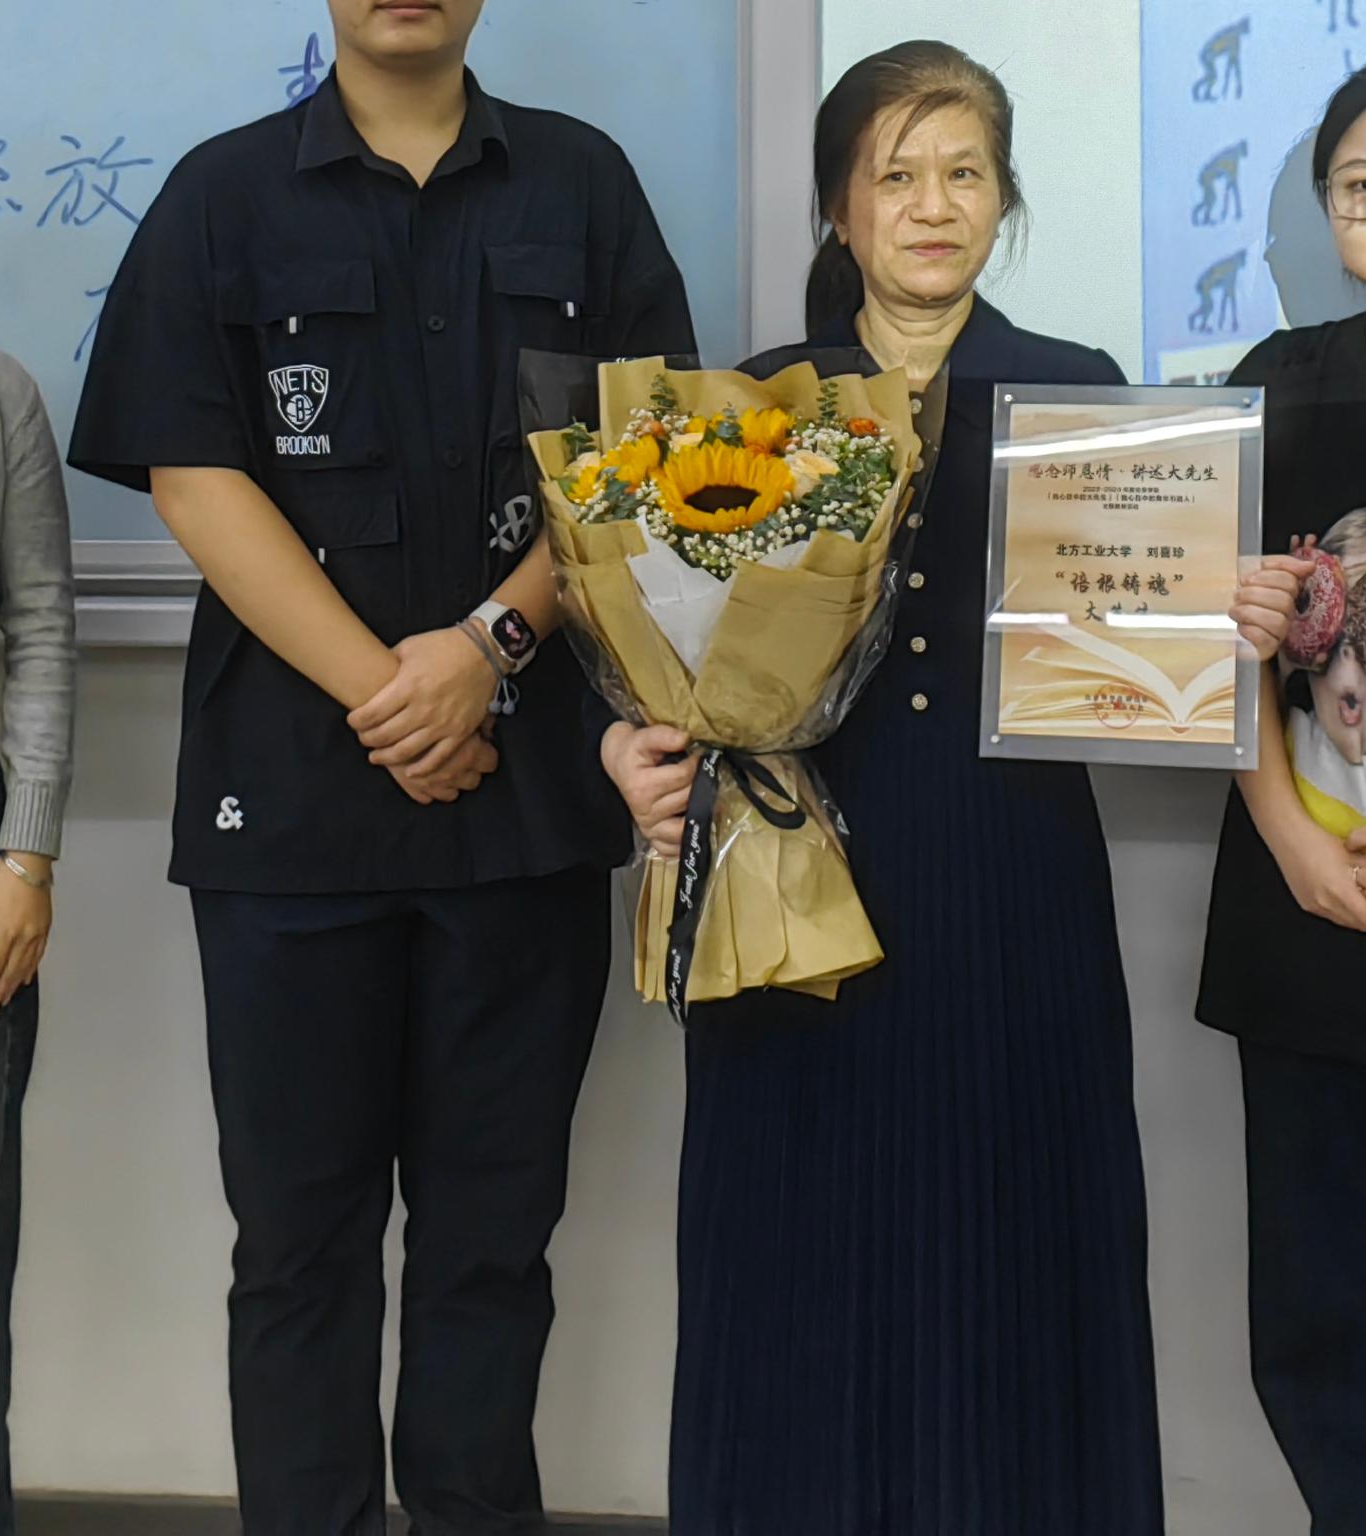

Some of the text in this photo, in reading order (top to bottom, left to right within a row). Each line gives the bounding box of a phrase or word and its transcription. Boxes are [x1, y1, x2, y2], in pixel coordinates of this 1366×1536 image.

[273, 367, 325, 395] NETS
[276, 434, 330, 454] BROOKLYN
[1056, 543, 1132, 557] 北方工业大学
